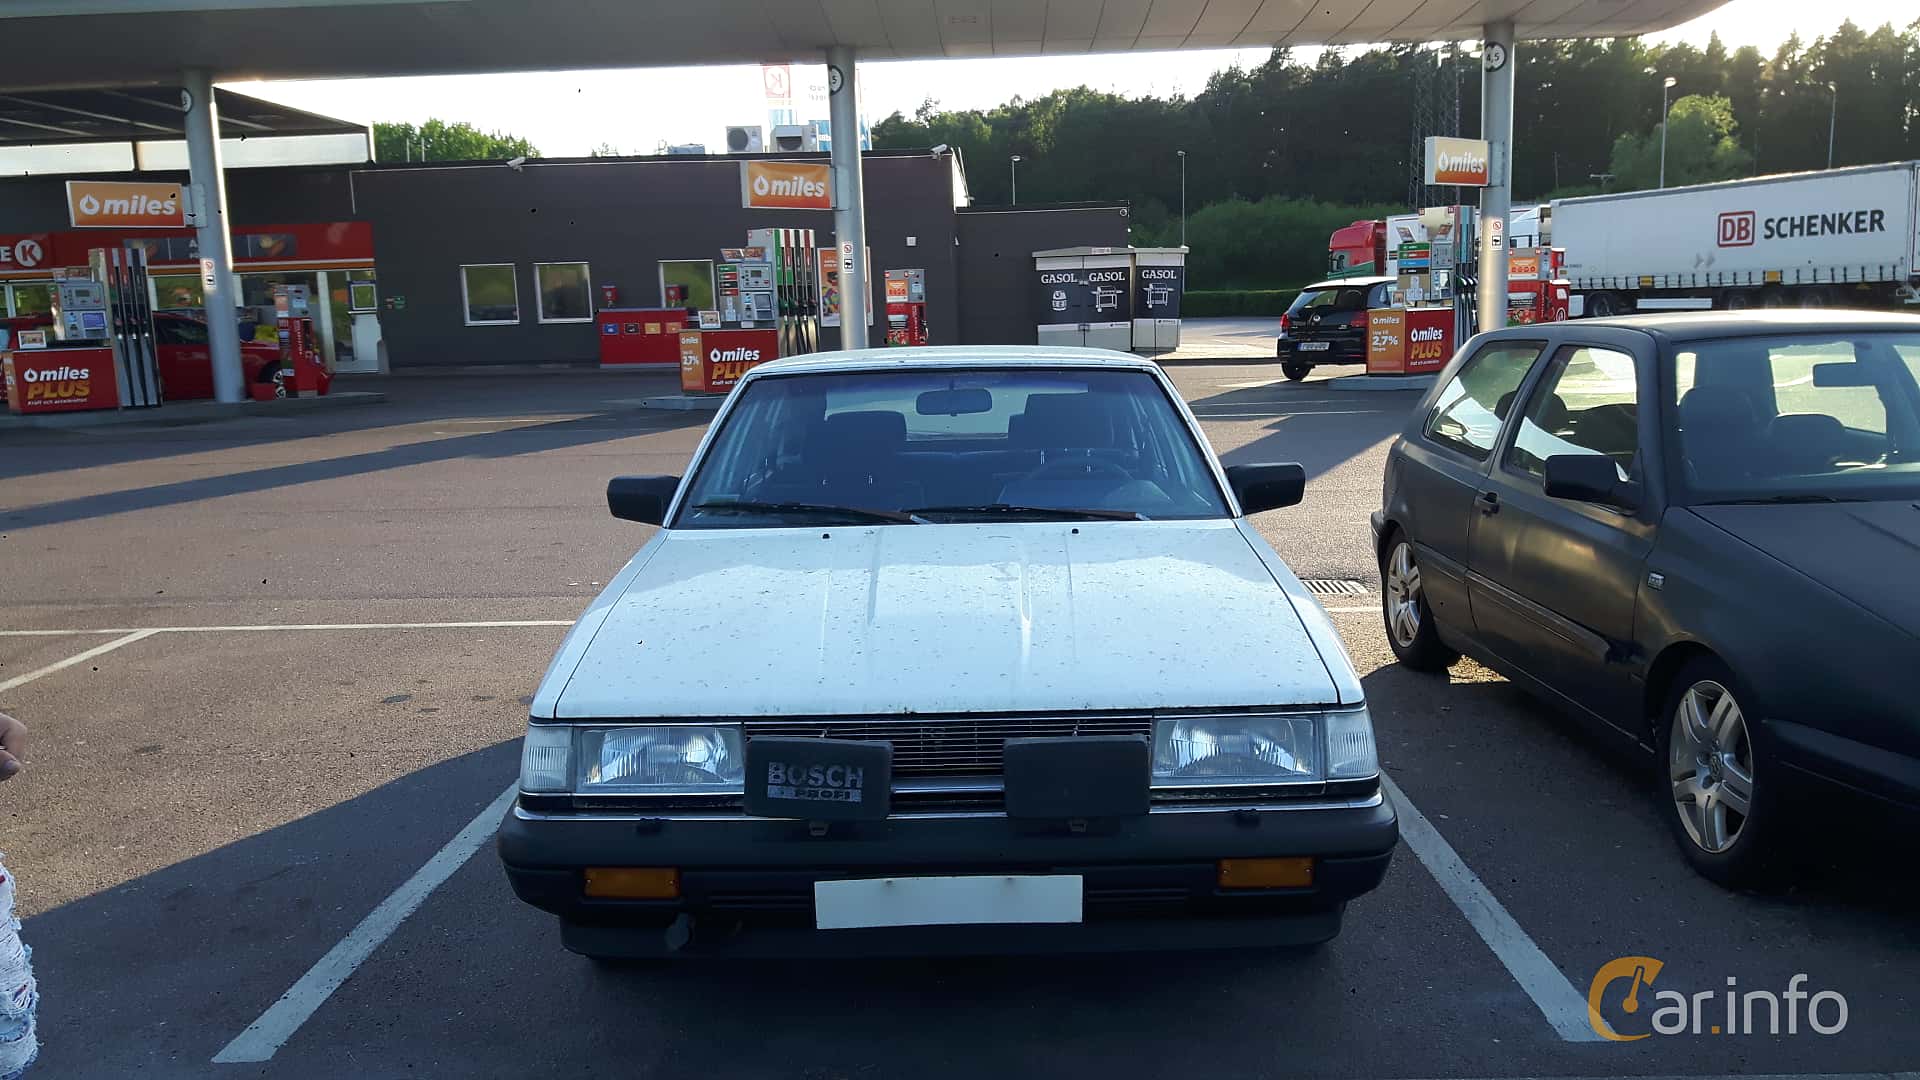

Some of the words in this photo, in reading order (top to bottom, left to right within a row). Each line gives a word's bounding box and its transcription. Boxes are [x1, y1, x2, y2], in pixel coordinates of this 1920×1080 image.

[1449, 152, 1485, 173] miles
[771, 176, 825, 197] miles
[103, 195, 176, 215] miles
[1722, 217, 1750, 242] DB
[1763, 209, 1886, 239] SCHENKER
[1040, 273, 1078, 284] GASOL
[1088, 271, 1126, 282] GASOL
[1141, 269, 1177, 279] GASOL
[1379, 316, 1400, 324] miles
[1418, 327, 1443, 341] miles
[721, 347, 760, 361] miles
[1410, 342, 1442, 360] PLUS
[39, 366, 89, 381] miles
[27, 381, 90, 399] PLUS
[768, 762, 864, 788] BOSCH
[795, 789, 851, 800] PROFI
